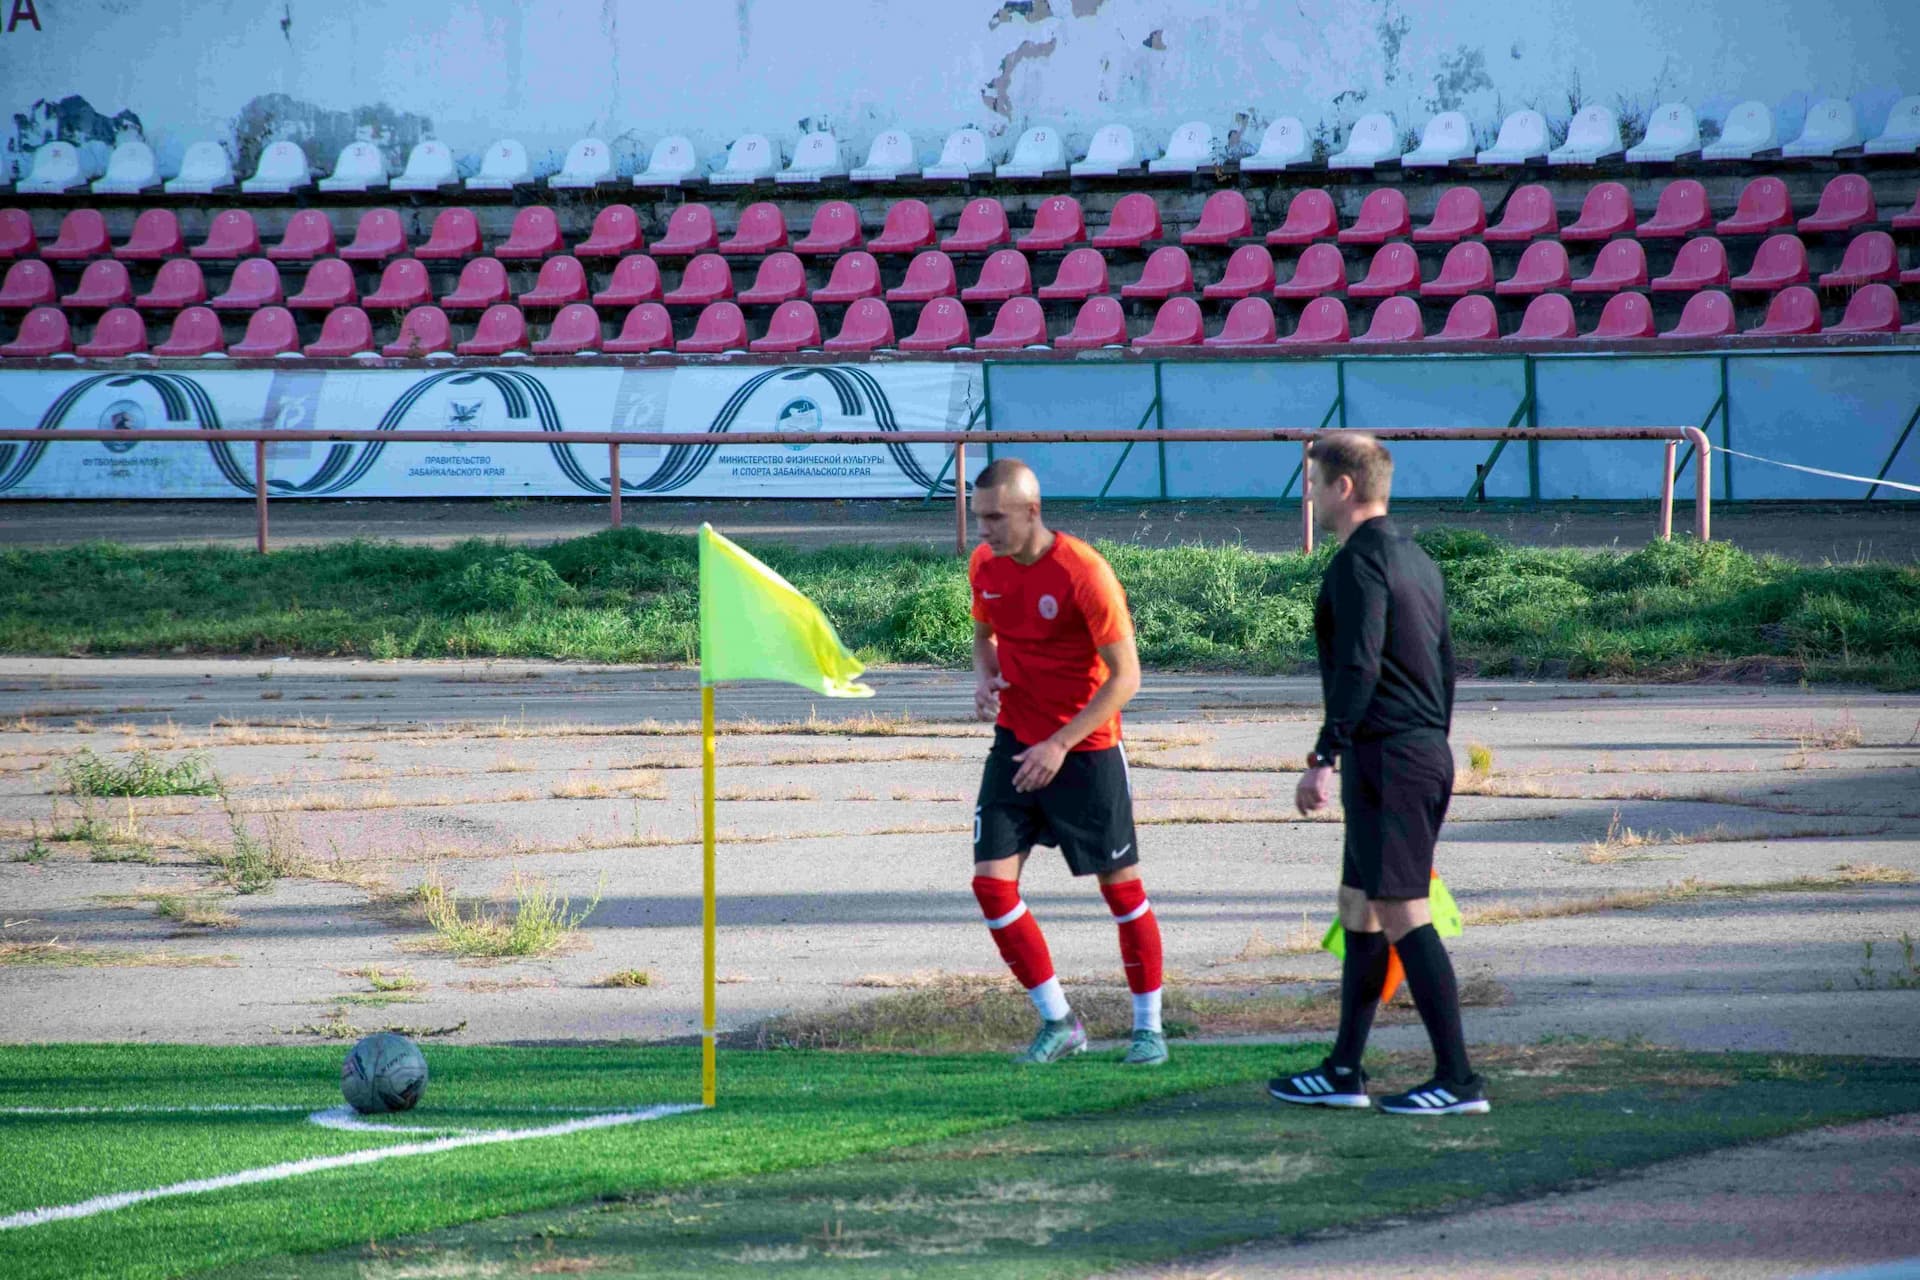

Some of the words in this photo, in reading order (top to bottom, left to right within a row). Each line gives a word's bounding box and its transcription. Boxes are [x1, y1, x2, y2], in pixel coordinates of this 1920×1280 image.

[0, 0, 42, 33] А
[1669, 111, 1678, 120] 15
[887, 135, 898, 145] 25
[1035, 131, 1046, 142] 23
[746, 142, 757, 152] 27
[1603, 190, 1612, 200] 15
[1054, 200, 1065, 210] 22
[1391, 249, 1400, 259] 17
[938, 304, 949, 314] 22
[1321, 304, 1329, 313] 17
[424, 456, 491, 465] ПРАВИТЕЛЬСТВО
[719, 455, 784, 464] МИНИСТЕРСТВО
[785, 453, 841, 464] ФИЗИЧЕСКОЙ
[843, 455, 885, 464] КУЛЬТУРЫ
[408, 466, 481, 476] ЗАБАЙКАЛЬСКОГО
[483, 468, 505, 476] КРАЯ
[732, 467, 738, 476] И
[740, 467, 771, 476] СПОРТА
[773, 465, 847, 476] ЗАБАЙКАЛЬСКОГО
[849, 467, 871, 476] КРАЯ
